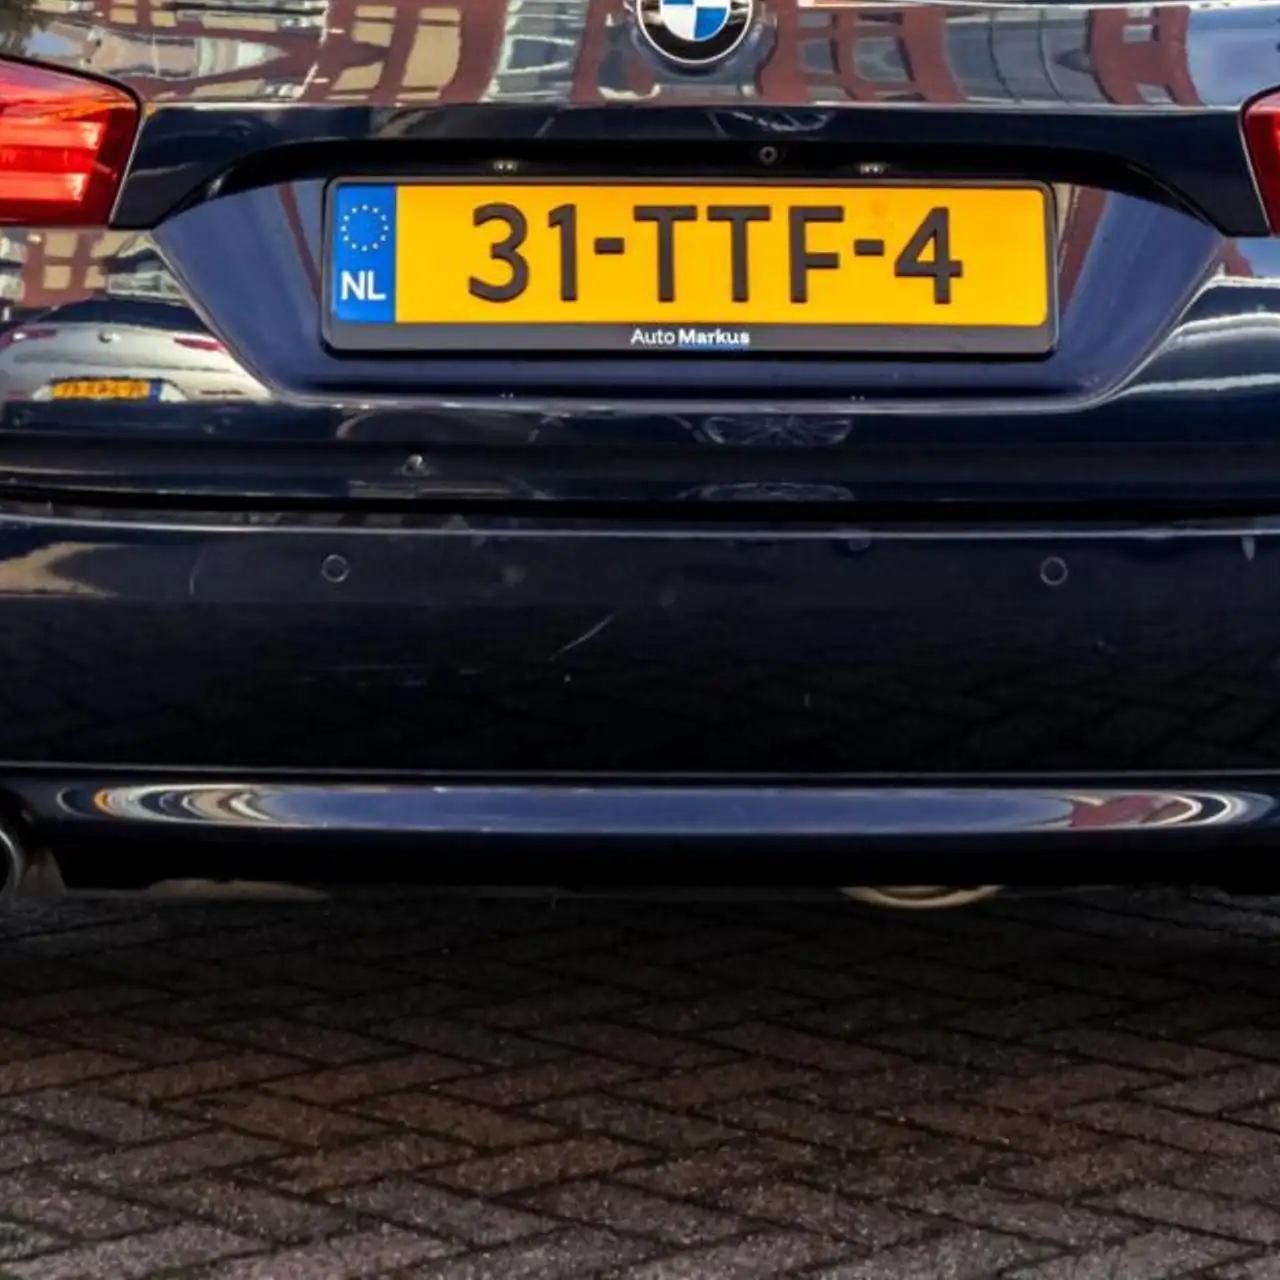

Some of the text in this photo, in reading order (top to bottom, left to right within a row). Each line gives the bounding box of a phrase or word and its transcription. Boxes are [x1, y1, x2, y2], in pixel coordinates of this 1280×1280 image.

[468, 203, 964, 306] 31-TTF-4
[340, 270, 386, 301] NL
[630, 327, 751, 346] Auto Markus
